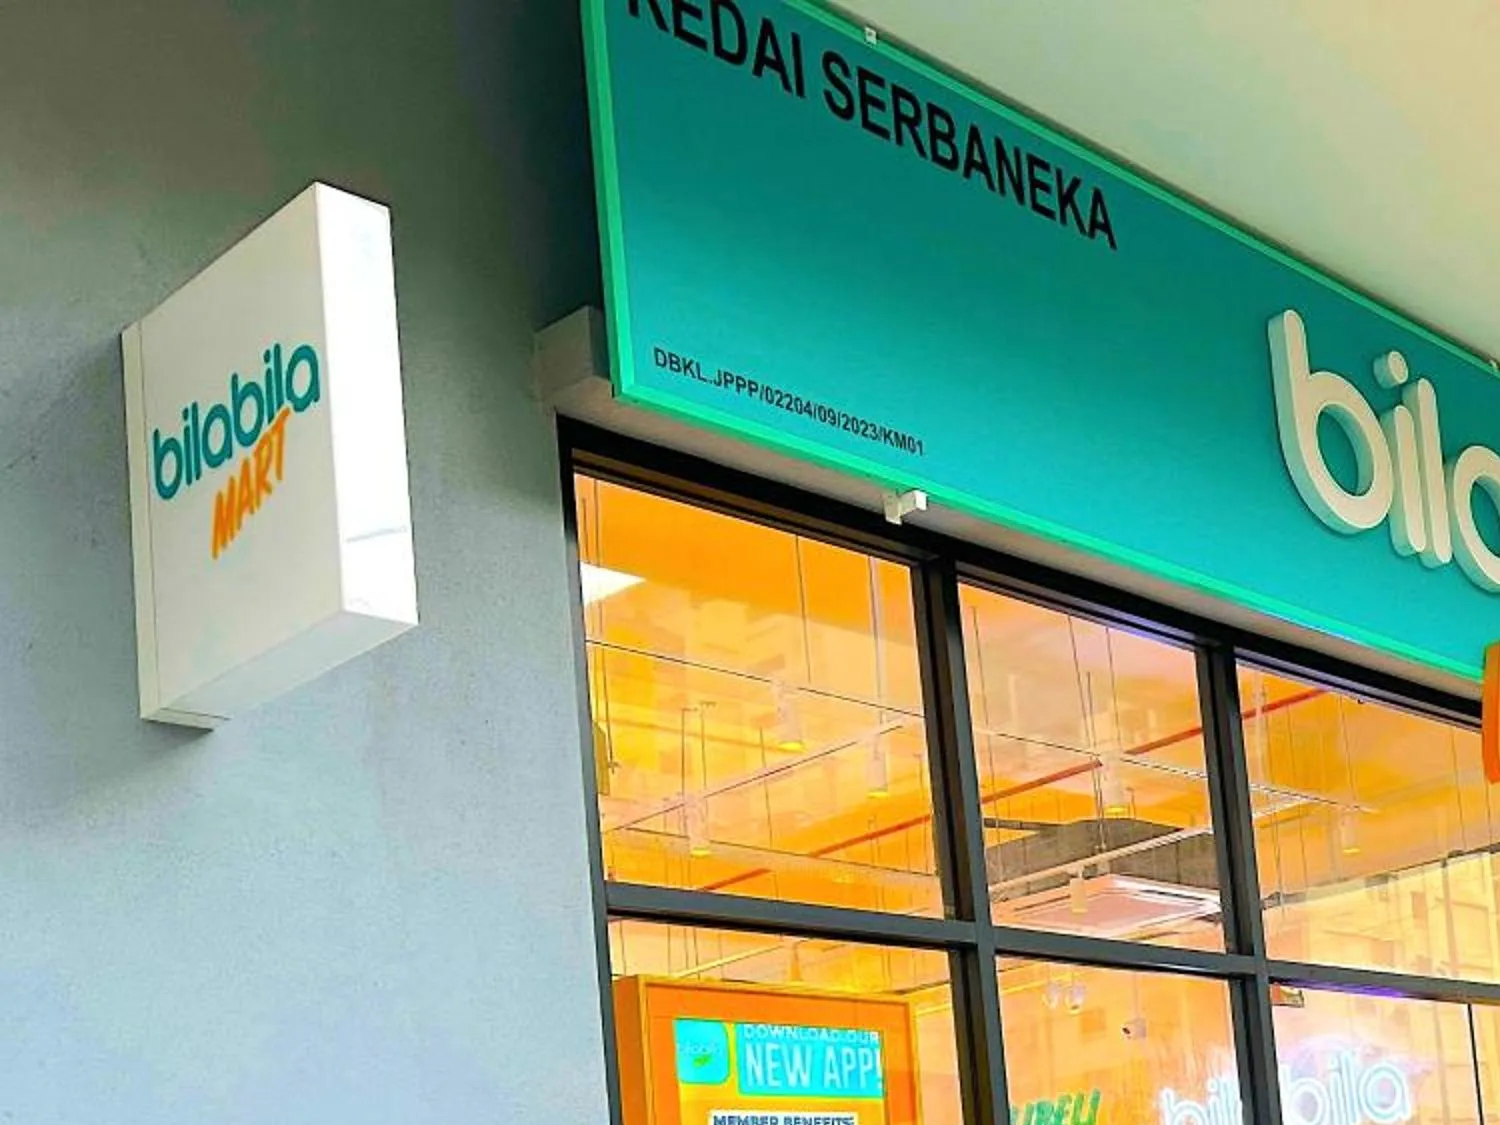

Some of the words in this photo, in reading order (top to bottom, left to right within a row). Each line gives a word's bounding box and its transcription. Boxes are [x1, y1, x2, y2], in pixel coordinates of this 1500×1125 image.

[821, 50, 1118, 251] SERBANEKA
[152, 343, 320, 500] bilabila
[210, 408, 290, 560] MART
[743, 1024, 840, 1043] DOWNLOAD
[745, 1041, 814, 1089] NEW
[823, 1046, 883, 1090] APP!
